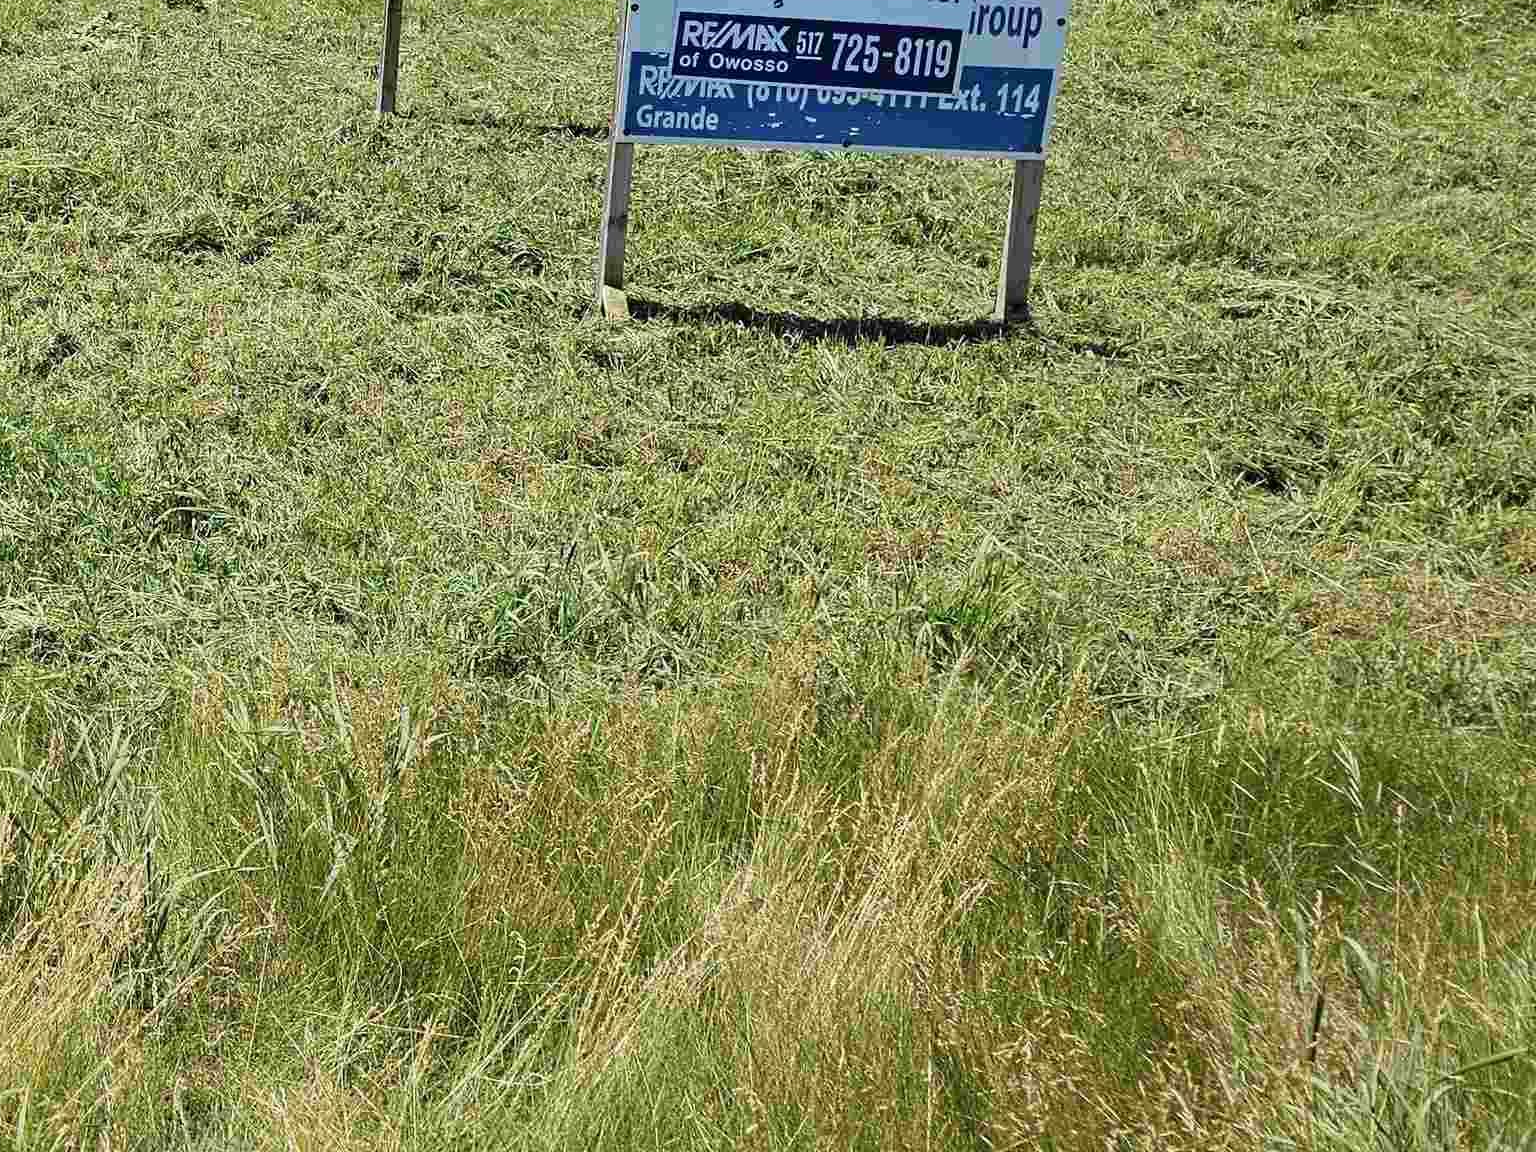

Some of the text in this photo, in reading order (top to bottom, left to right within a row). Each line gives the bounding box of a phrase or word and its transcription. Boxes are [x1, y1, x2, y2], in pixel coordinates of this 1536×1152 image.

[679, 52, 789, 73] of Owosso
[681, 20, 953, 79] RE/MAX 517 725-8119
[997, 84, 1041, 113] 114
[636, 105, 719, 131] Grande
